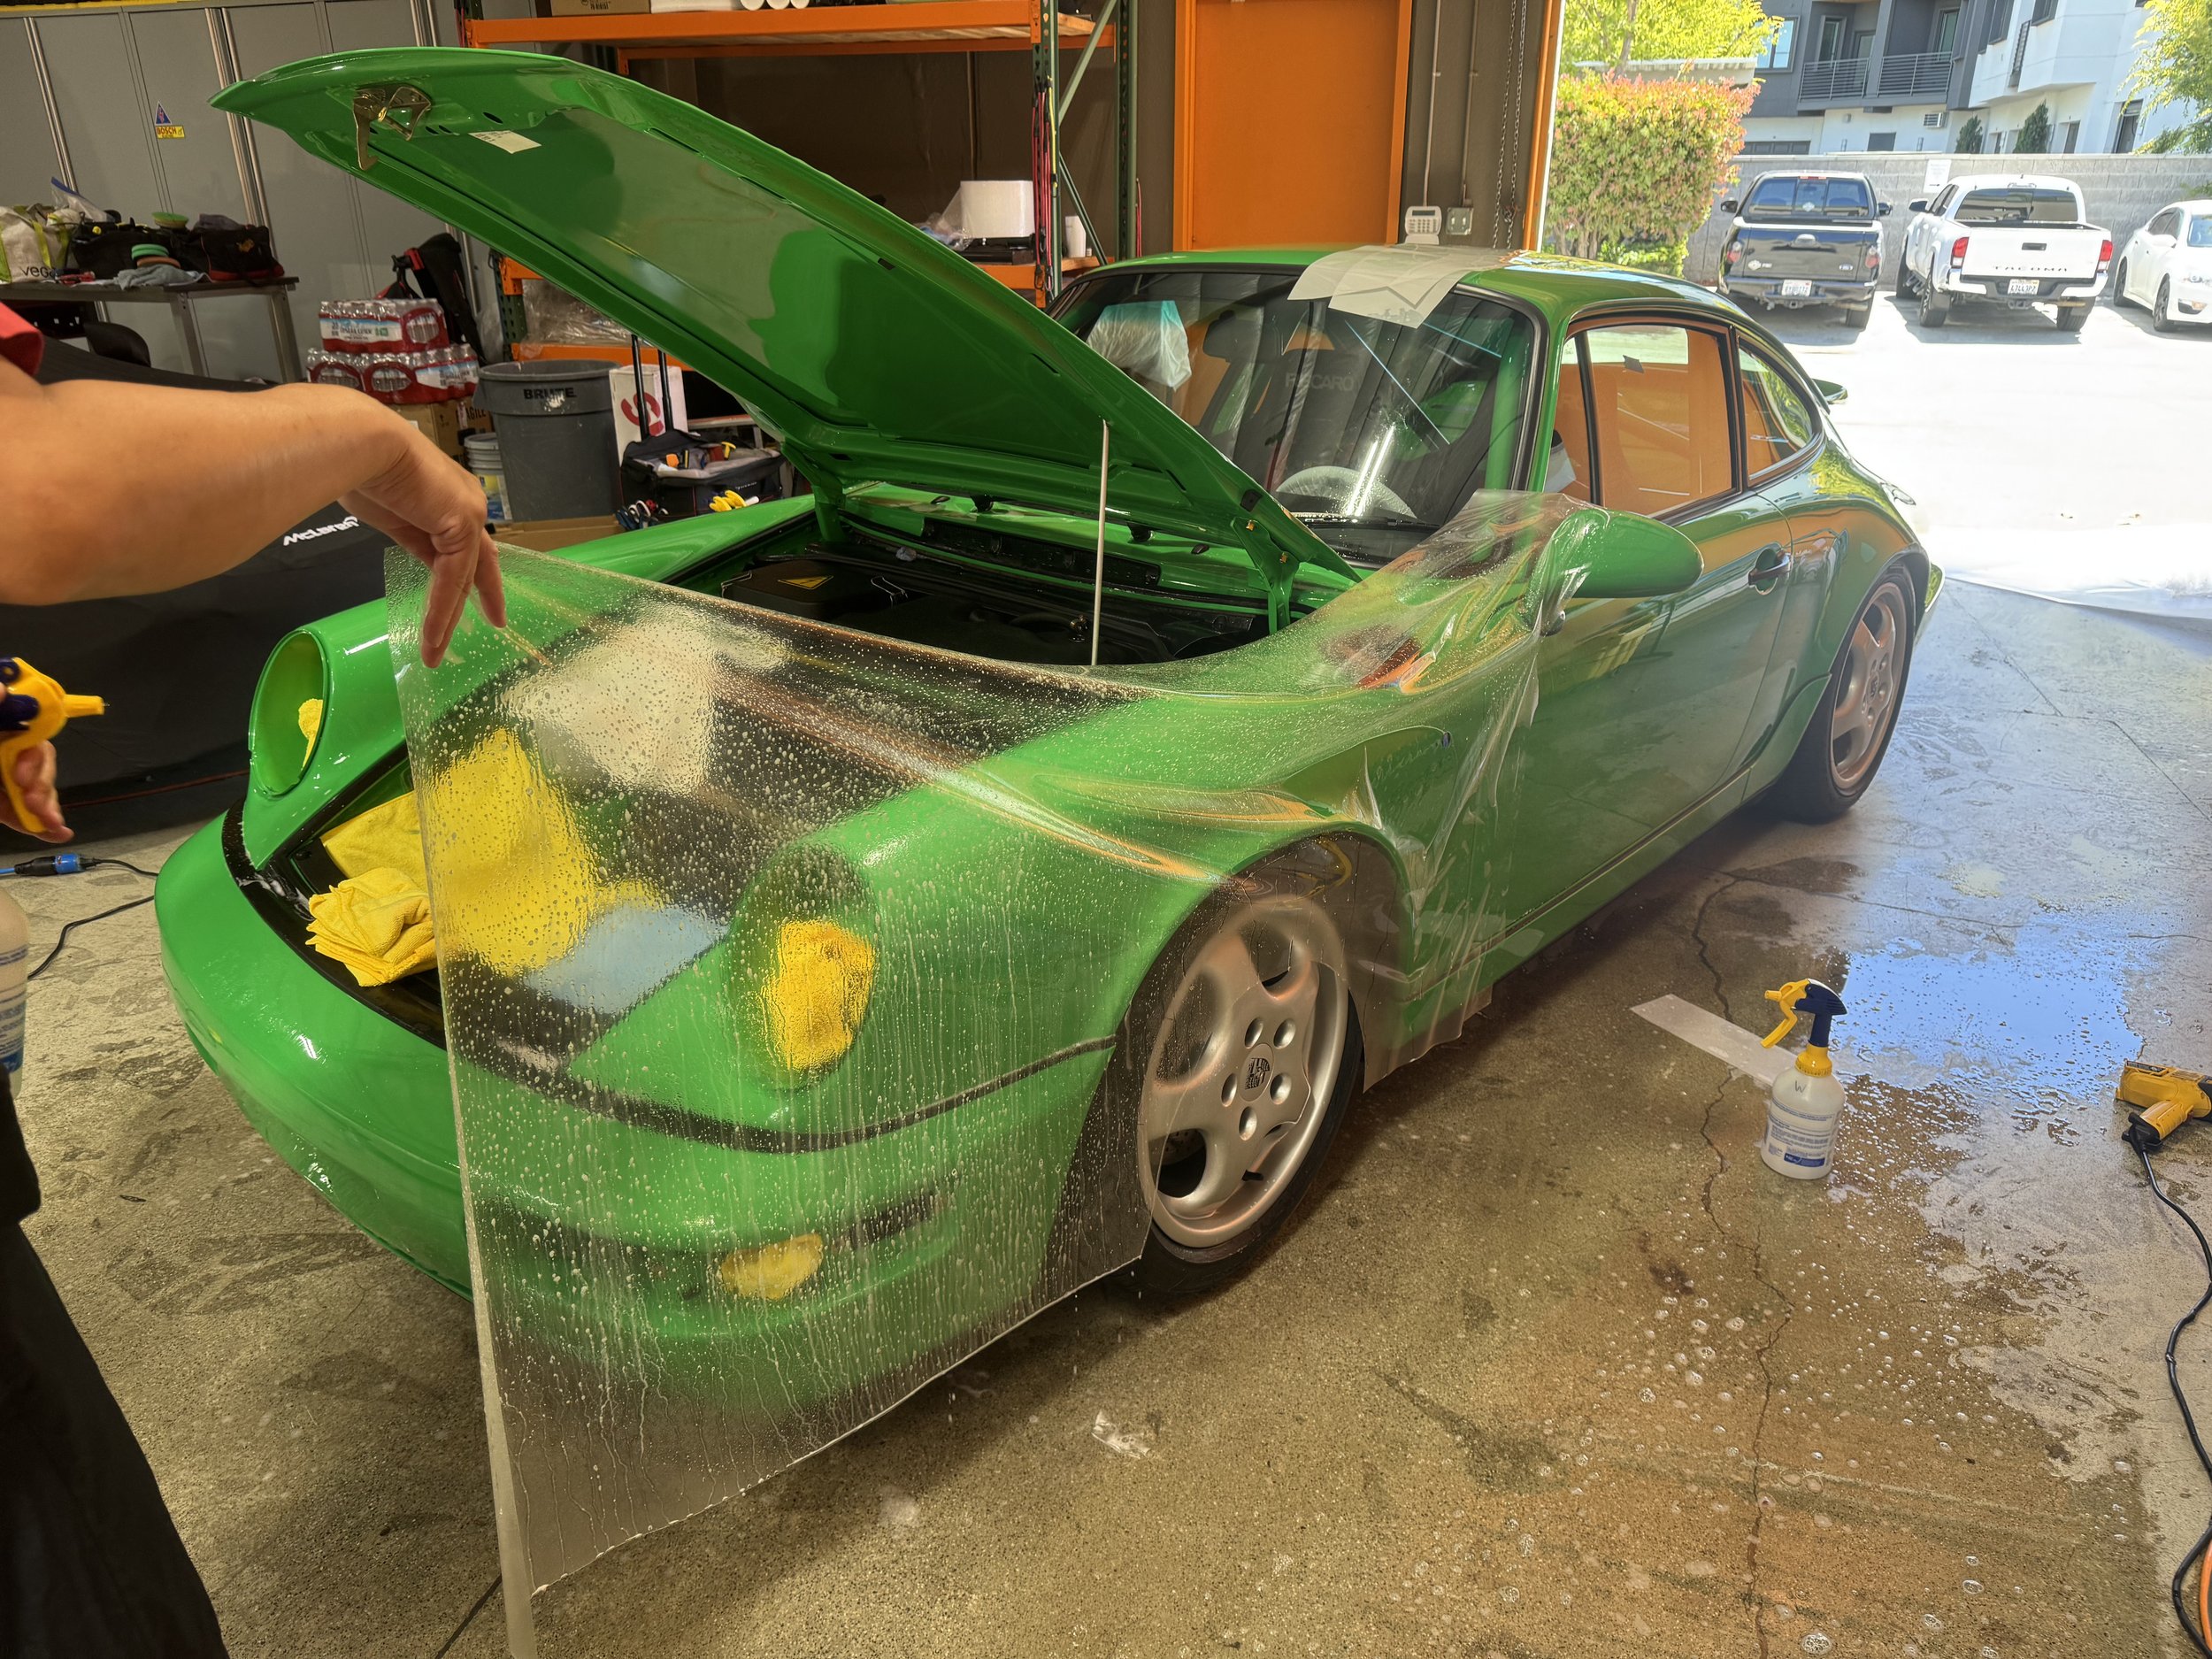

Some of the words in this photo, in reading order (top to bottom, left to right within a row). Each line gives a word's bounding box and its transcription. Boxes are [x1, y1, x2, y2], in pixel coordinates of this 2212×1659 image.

[1285, 373, 1354, 392] RCARO
[283, 516, 359, 546] McLaren
[1794, 1079, 1807, 1094] W
